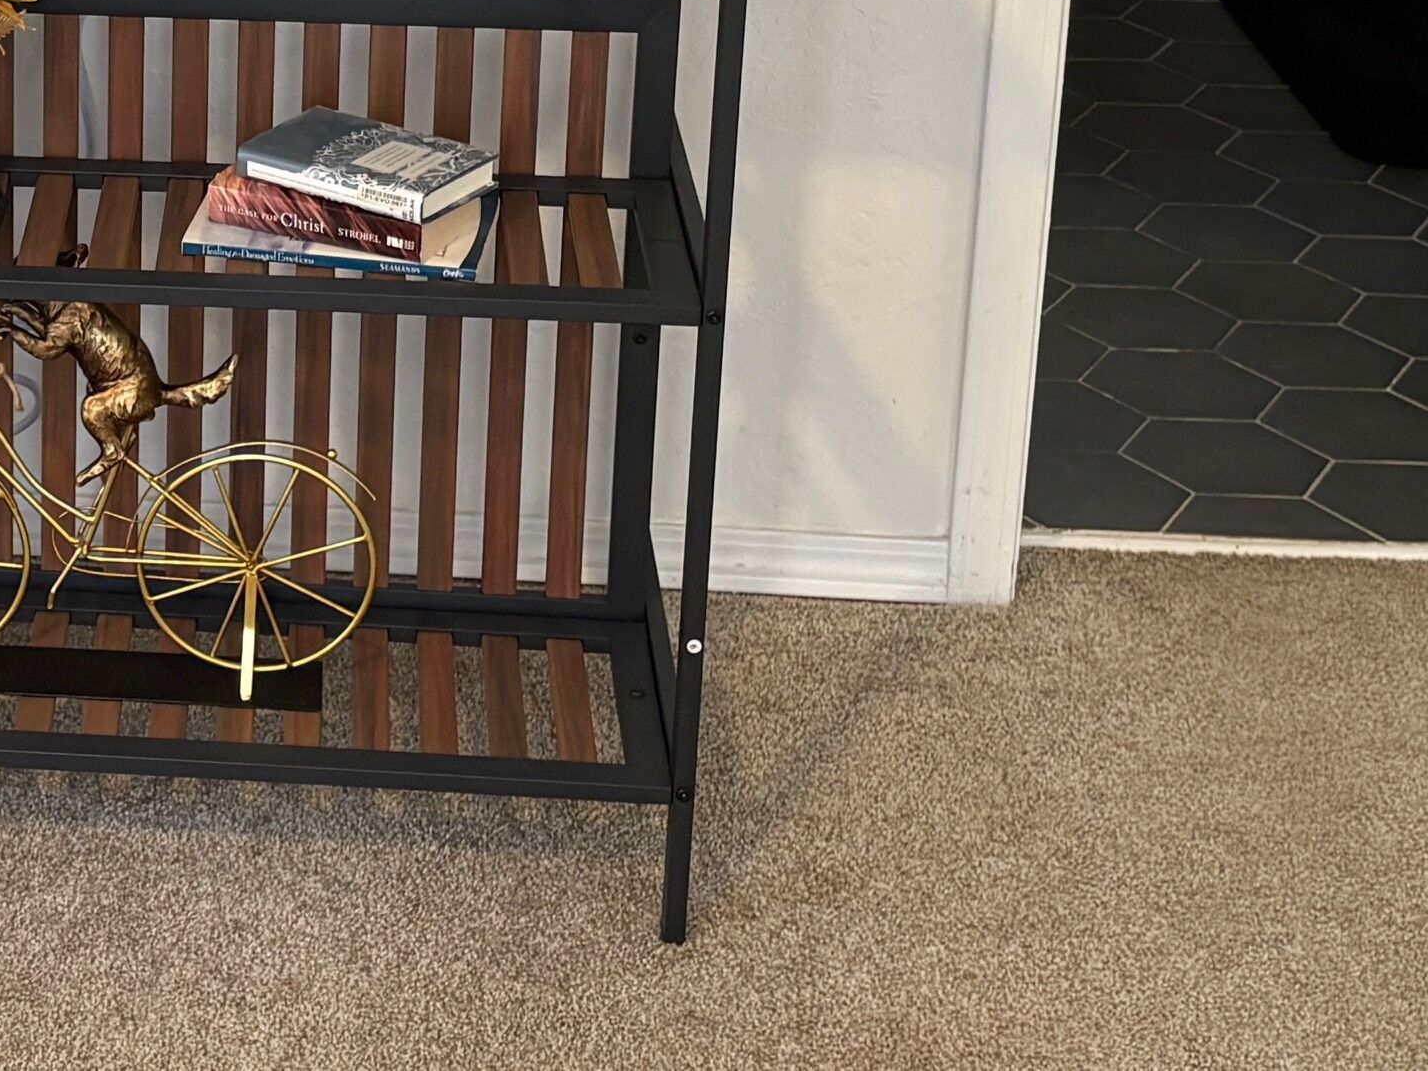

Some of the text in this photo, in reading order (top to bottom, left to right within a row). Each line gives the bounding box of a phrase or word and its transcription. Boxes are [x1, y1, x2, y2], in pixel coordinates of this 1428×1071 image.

[219, 204, 237, 214] THE
[237, 208, 260, 219] CASE
[279, 212, 325, 234] Christ
[337, 227, 382, 245] STROBEL
[277, 251, 315, 265] Emotions
[379, 262, 421, 274] SEAMANDS
